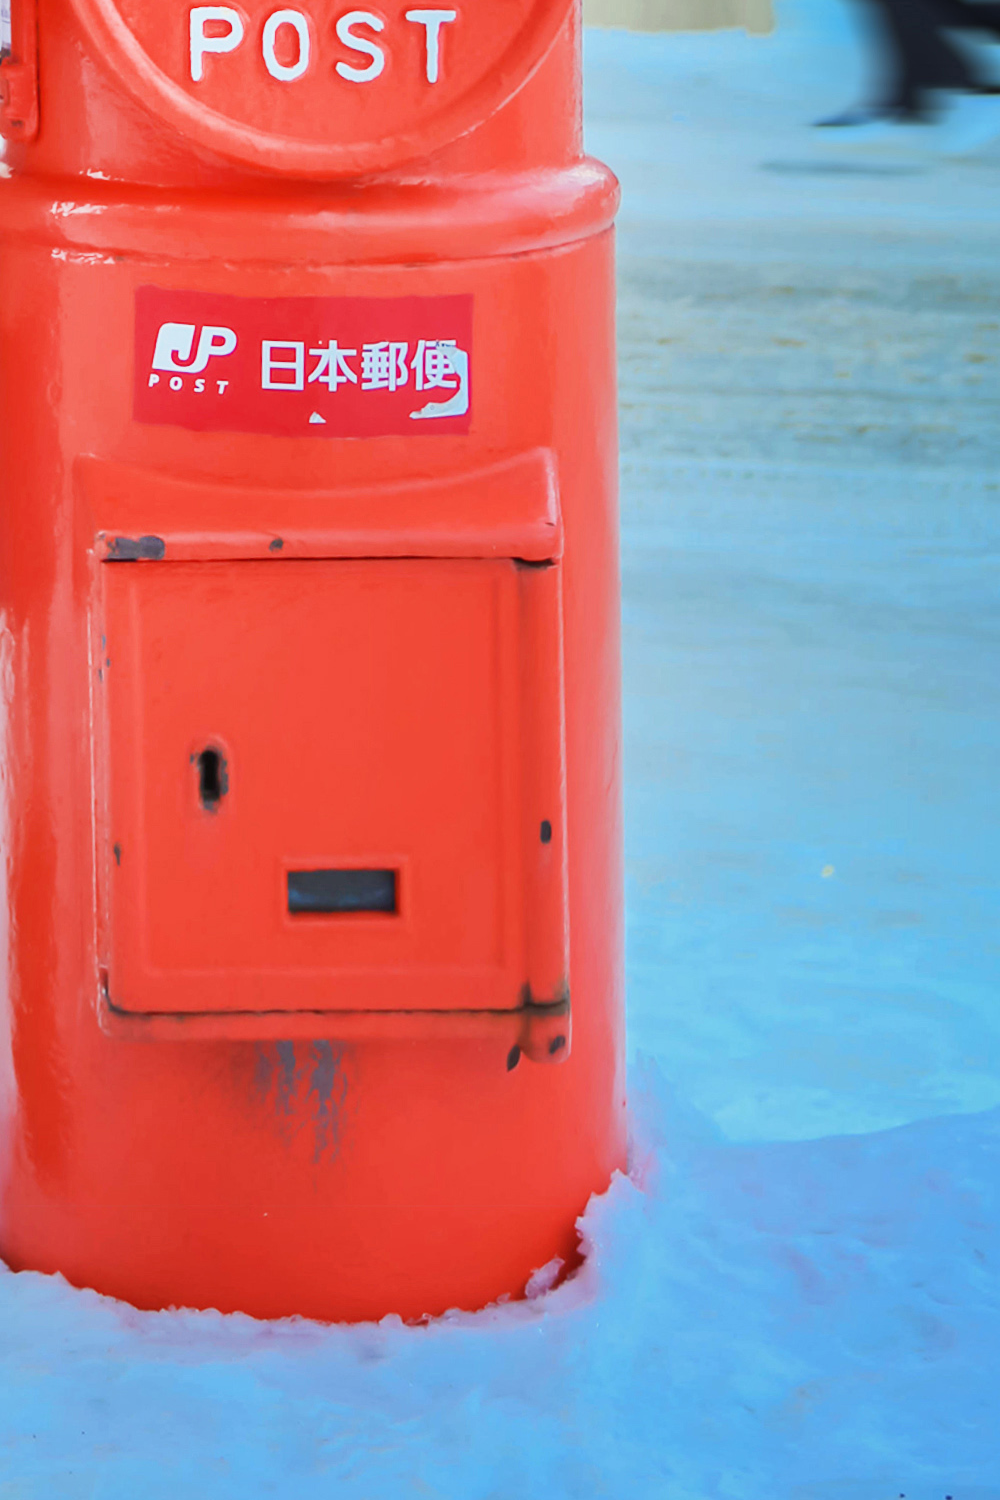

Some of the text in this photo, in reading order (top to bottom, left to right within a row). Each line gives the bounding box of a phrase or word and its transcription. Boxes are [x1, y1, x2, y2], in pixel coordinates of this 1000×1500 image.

[189, 6, 457, 84] POST
[148, 373, 229, 395] POST
[261, 339, 457, 392] 日本郵便
